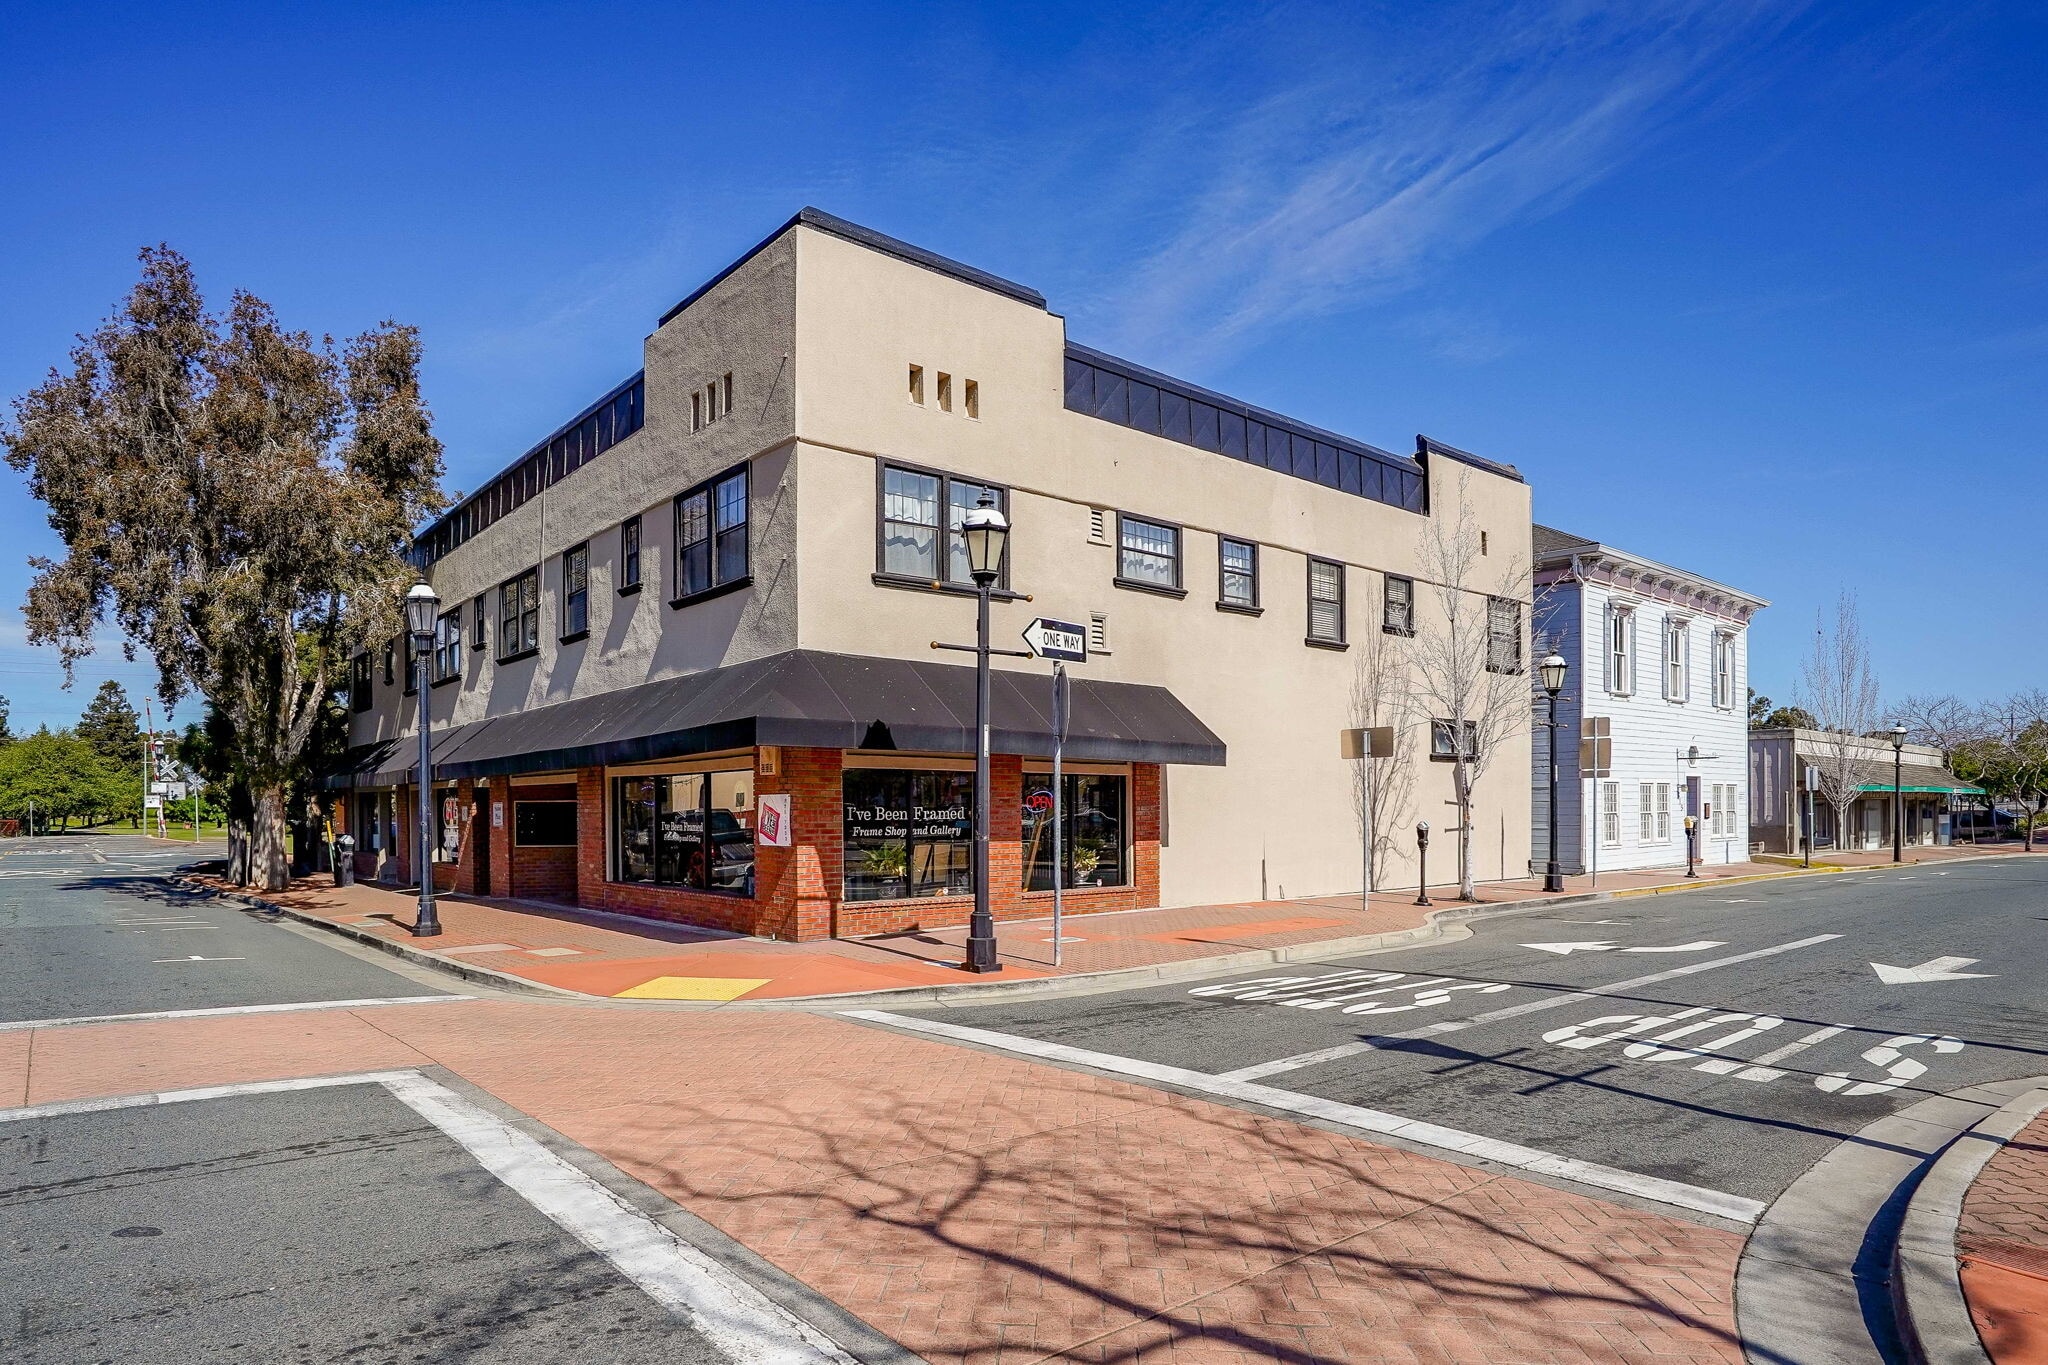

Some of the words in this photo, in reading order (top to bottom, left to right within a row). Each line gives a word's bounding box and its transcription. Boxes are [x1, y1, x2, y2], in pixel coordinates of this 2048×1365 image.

[1043, 632, 1061, 647] ONE
[1063, 634, 1080, 650] WAY
[1026, 795, 1053, 809] OPEN
[846, 806, 872, 821] I've
[875, 806, 908, 821] Been
[913, 806, 966, 820] Framed
[852, 826, 883, 837] Frame
[884, 826, 907, 838] Shop
[913, 826, 928, 835] and
[930, 825, 962, 837] Gallery
[1188, 969, 1511, 1016] STOP
[1542, 1006, 1964, 1096] STOP
